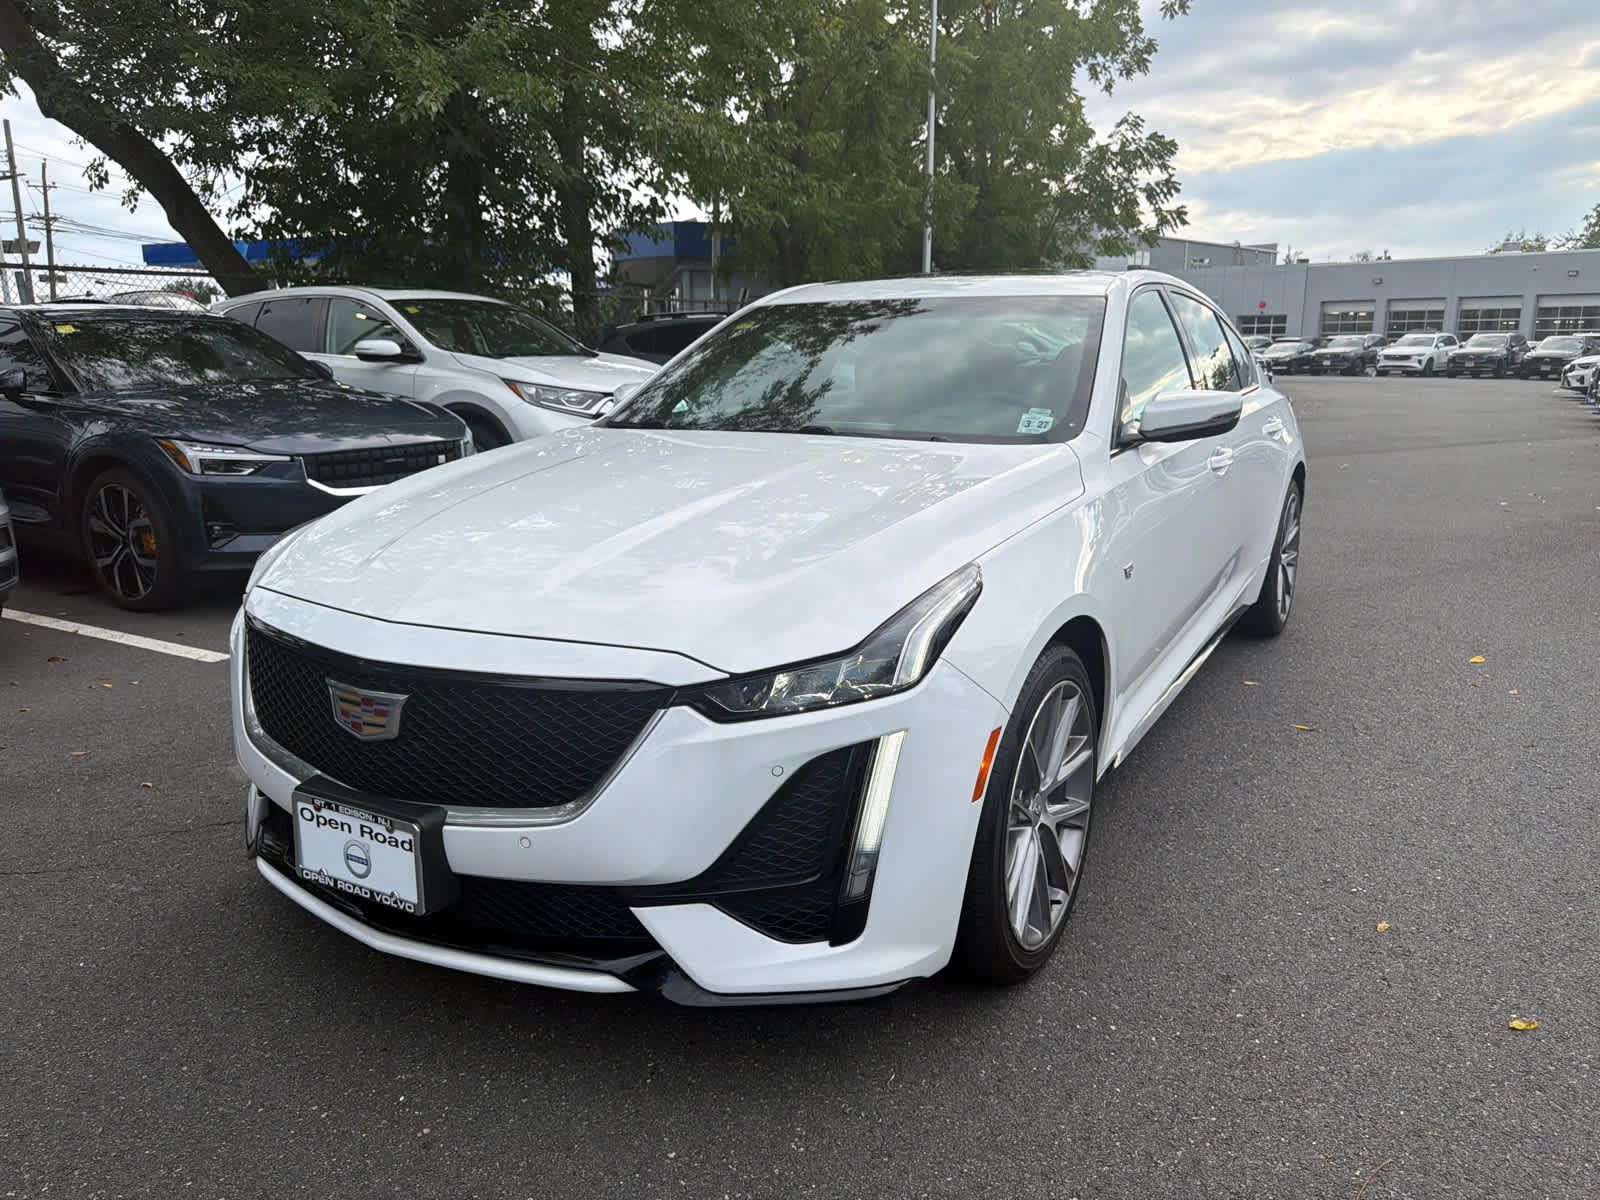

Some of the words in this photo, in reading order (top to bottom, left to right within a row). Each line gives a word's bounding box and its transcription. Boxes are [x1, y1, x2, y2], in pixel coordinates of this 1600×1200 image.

[300, 807, 352, 834] Open
[360, 823, 413, 853] Road
[303, 871, 334, 887] OPEN
[337, 880, 370, 898] ROAD
[374, 892, 414, 913] VOLVO
